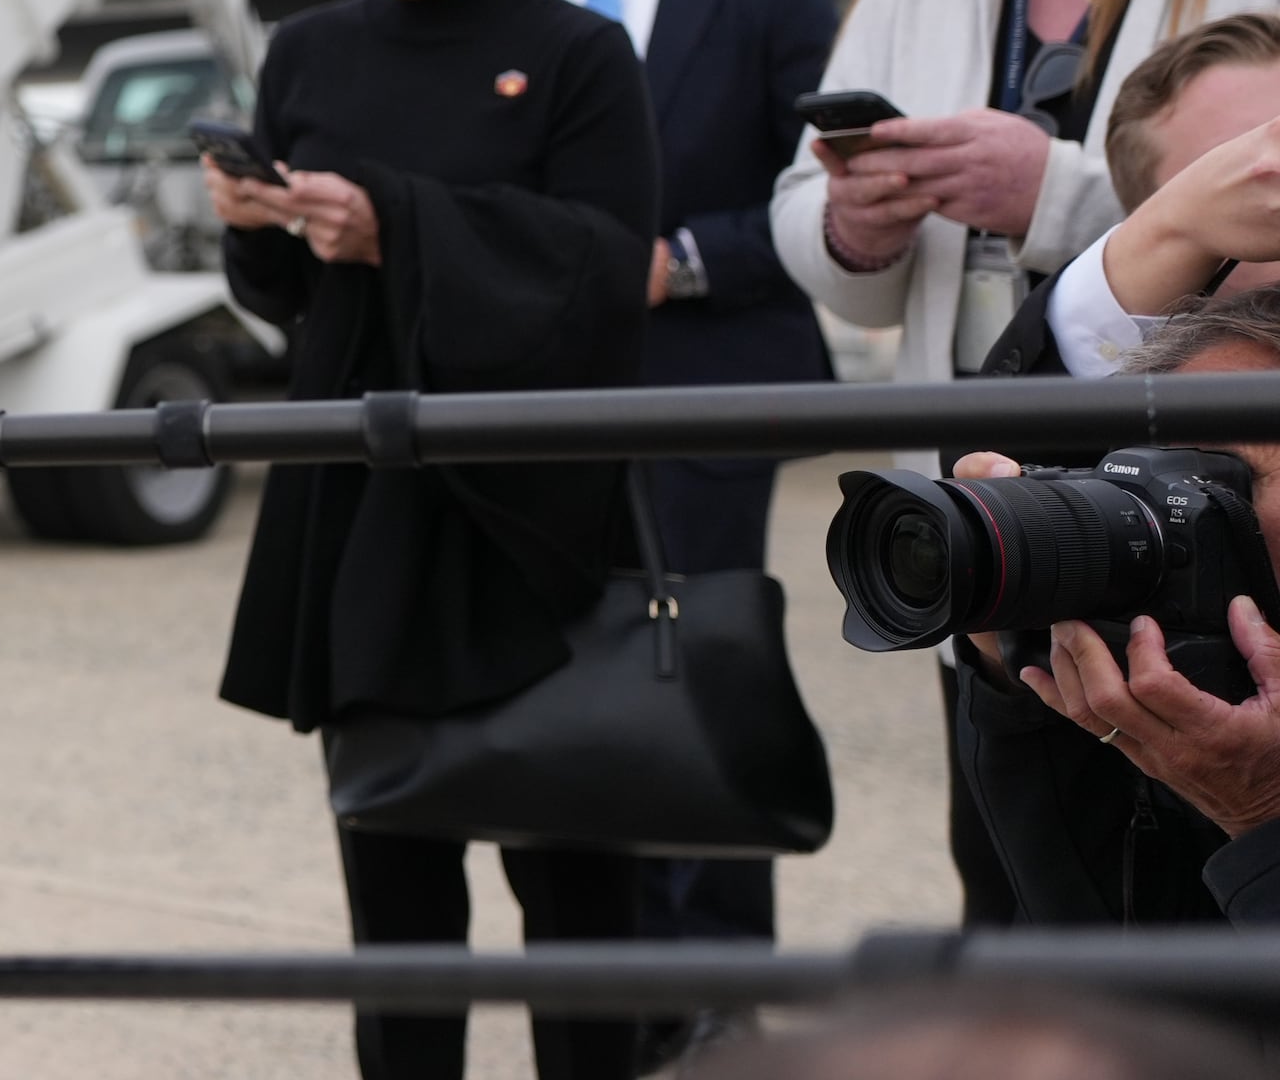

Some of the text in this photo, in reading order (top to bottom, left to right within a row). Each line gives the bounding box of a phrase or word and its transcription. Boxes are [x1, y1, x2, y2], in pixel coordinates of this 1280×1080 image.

[1104, 462, 1140, 476] Canon
[1166, 496, 1188, 505] EOS
[1171, 508, 1182, 517] R5
